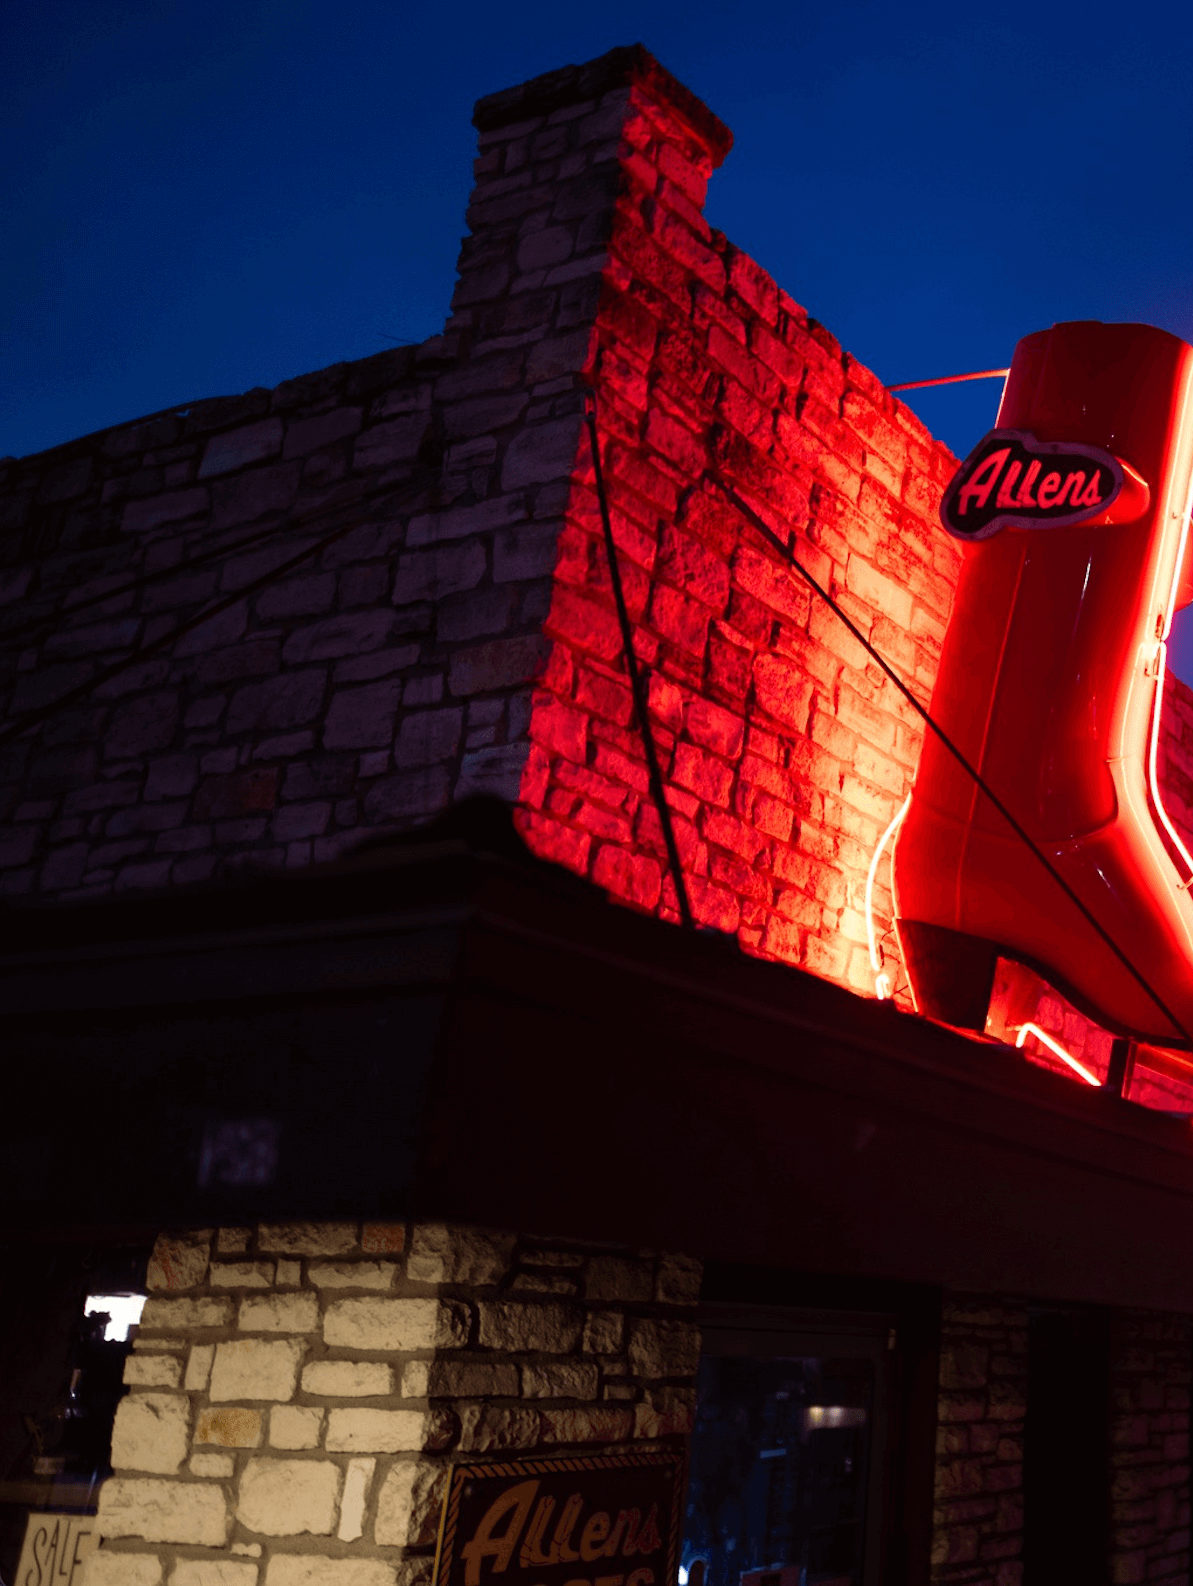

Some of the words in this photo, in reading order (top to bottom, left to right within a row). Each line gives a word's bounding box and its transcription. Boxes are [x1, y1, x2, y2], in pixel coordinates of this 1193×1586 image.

[957, 447, 1102, 515] Allens
[26, 1520, 91, 1586] SALE
[460, 1479, 662, 1586] Allens
